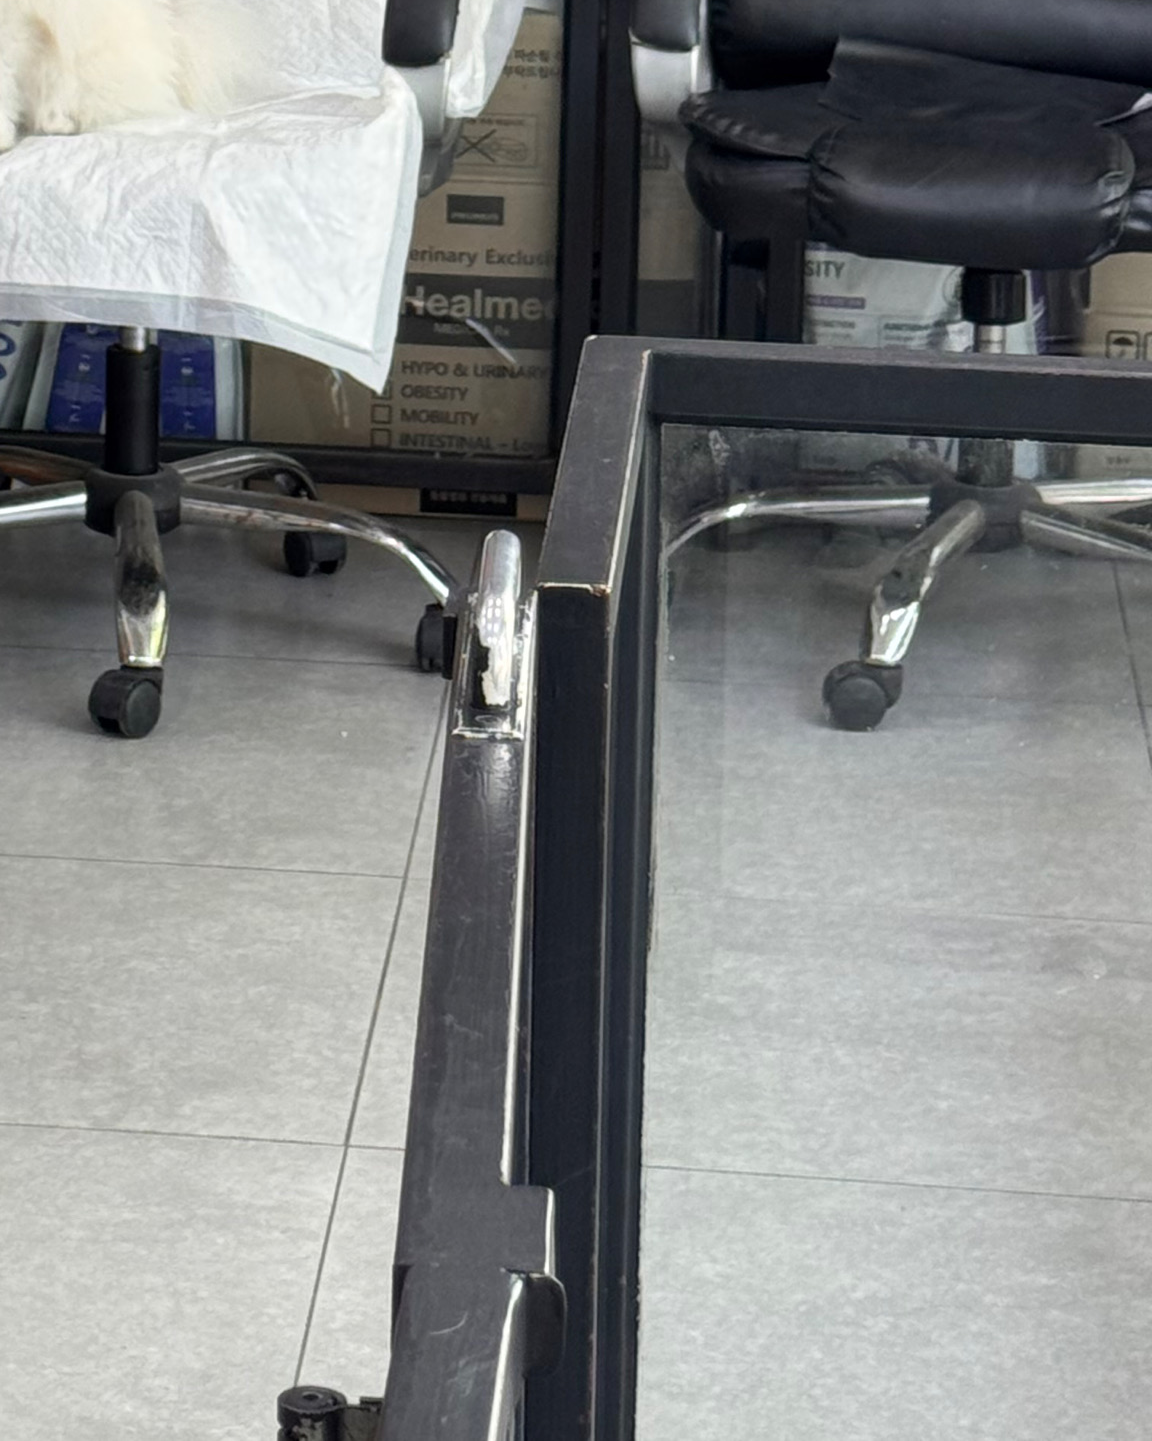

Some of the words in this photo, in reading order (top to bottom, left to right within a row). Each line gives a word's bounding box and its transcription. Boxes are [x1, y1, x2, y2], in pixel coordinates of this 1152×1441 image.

[408, 245, 478, 269] erinary
[804, 260, 846, 280] SITY
[401, 360, 449, 377] HYPO
[453, 362, 469, 378] &
[401, 384, 469, 402] OBESITY
[400, 408, 480, 426] MOBILITY
[399, 432, 493, 451] INTESTINAL
